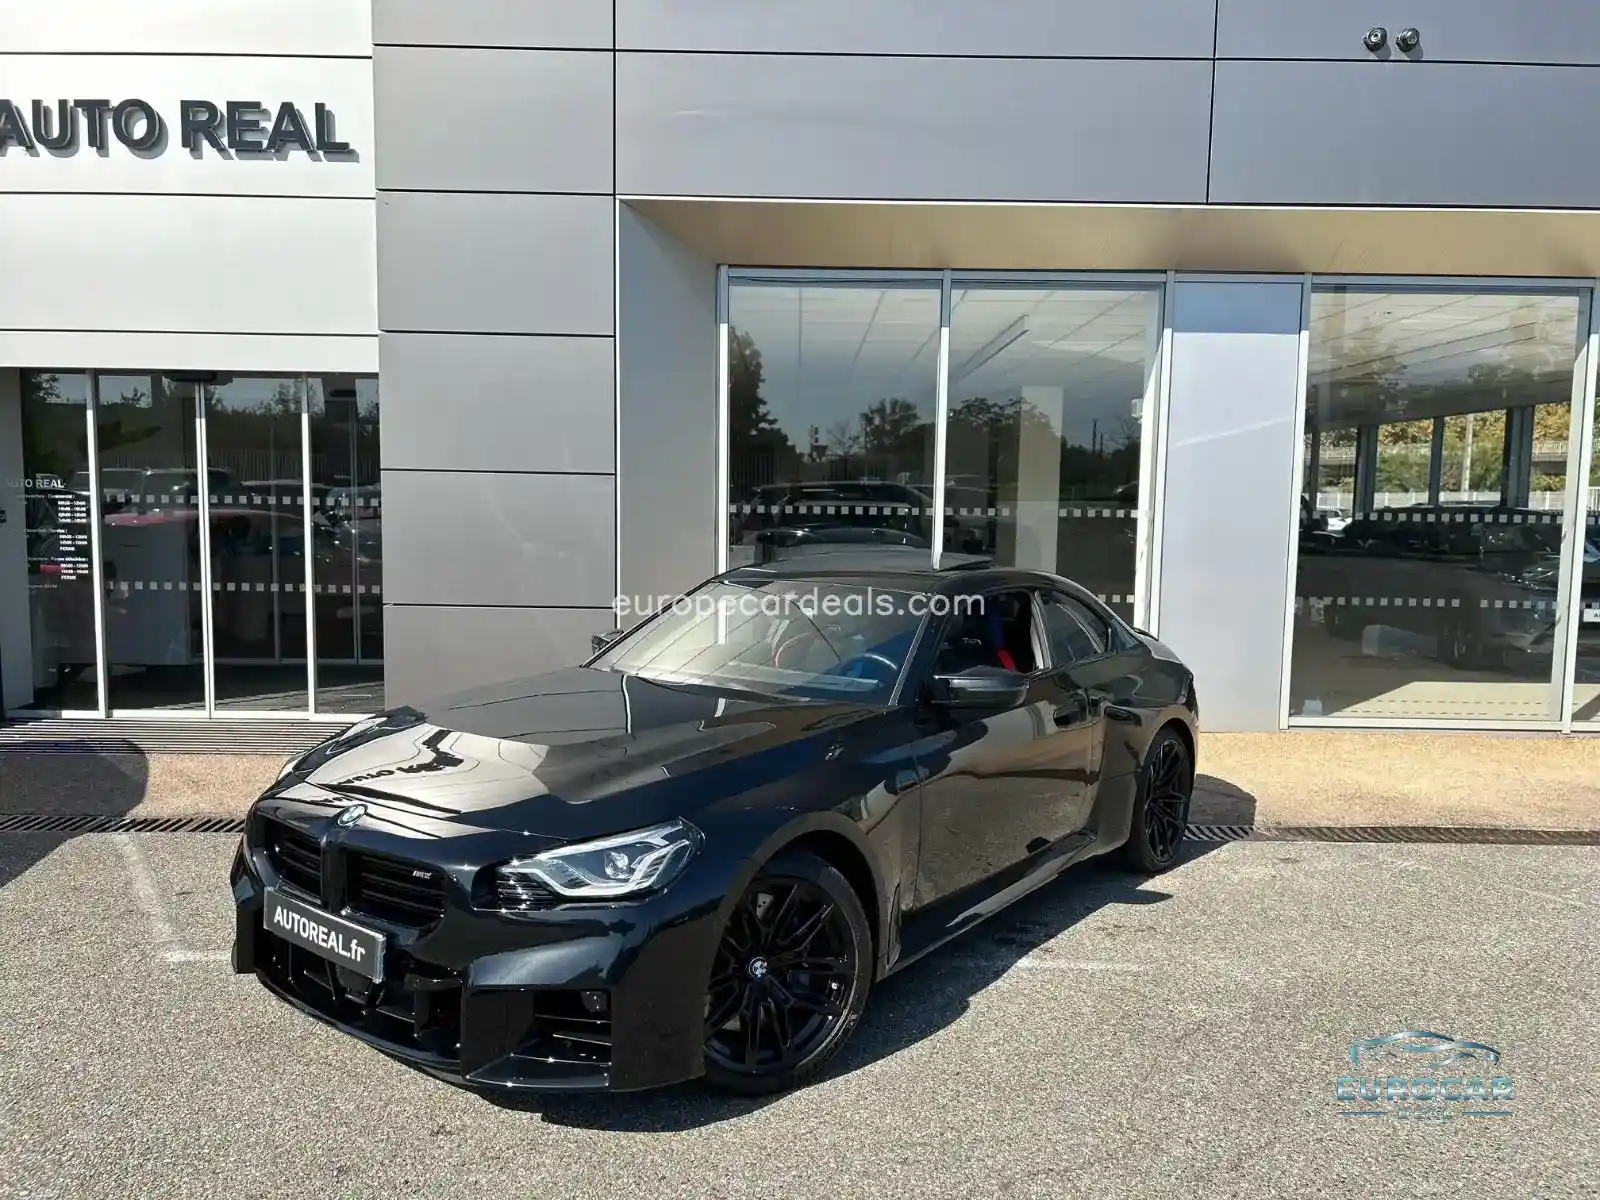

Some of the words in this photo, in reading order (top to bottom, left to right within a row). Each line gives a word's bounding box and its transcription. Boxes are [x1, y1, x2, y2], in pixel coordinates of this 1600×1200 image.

[0, 98, 160, 152] AUTO
[180, 100, 352, 153] REAL
[36, 478, 65, 488] REAL
[273, 905, 366, 962] AUTOREAL.fr
